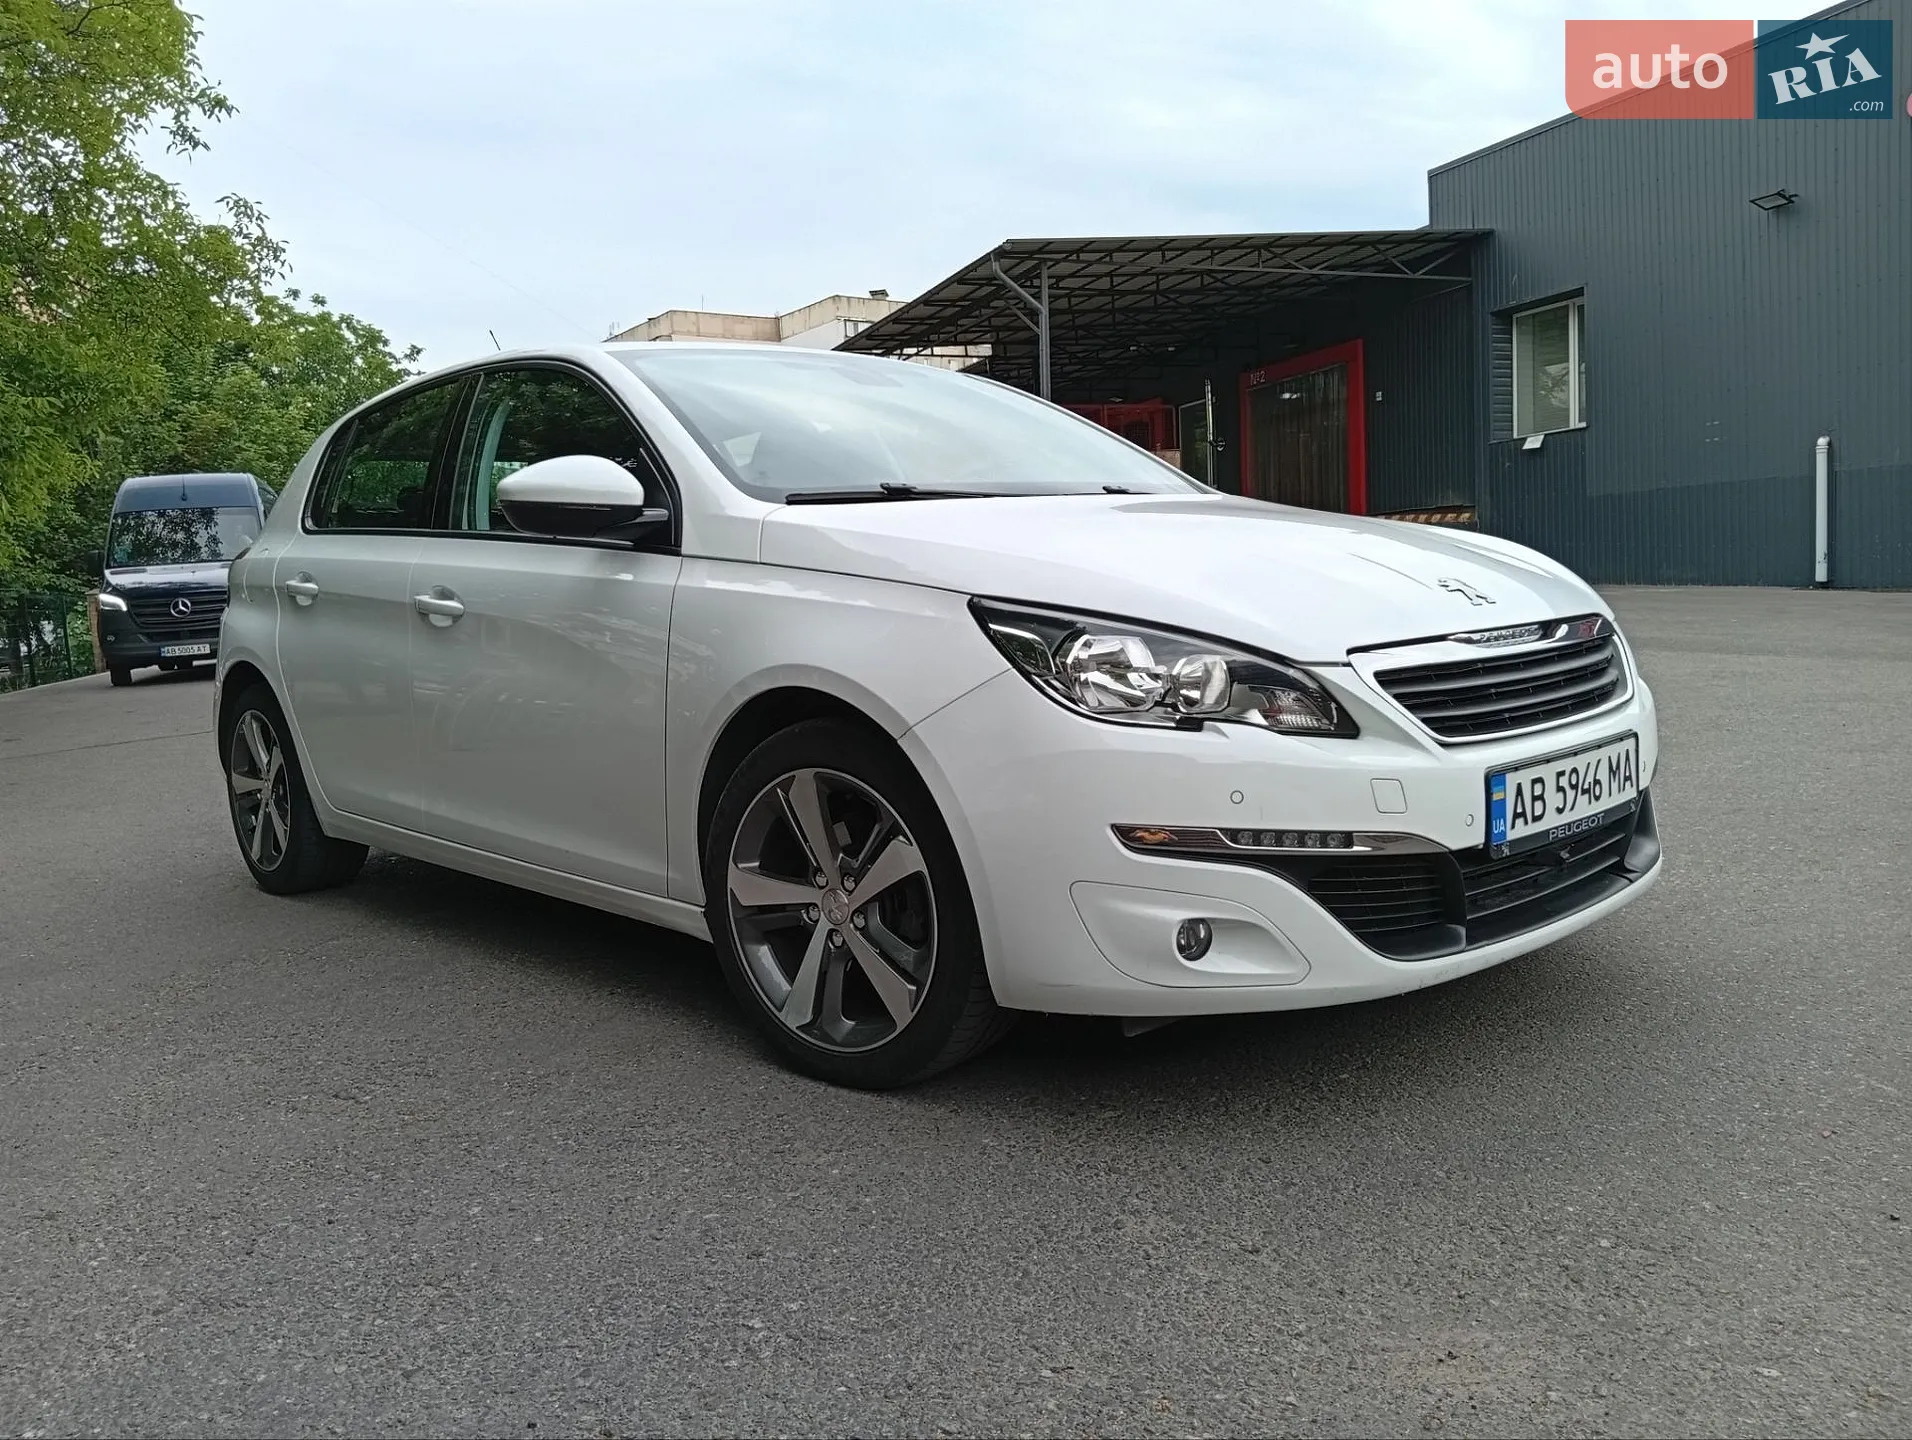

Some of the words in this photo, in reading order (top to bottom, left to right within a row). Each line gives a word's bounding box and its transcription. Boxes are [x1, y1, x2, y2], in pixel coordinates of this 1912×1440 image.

[165, 647, 177, 656] AB
[178, 645, 195, 655] 5005
[1510, 775, 1547, 831] AB
[1554, 758, 1604, 815] 5946
[1608, 748, 1635, 798] MA
[1492, 819, 1506, 835] UA
[1549, 812, 1605, 841] PEUGEOT
